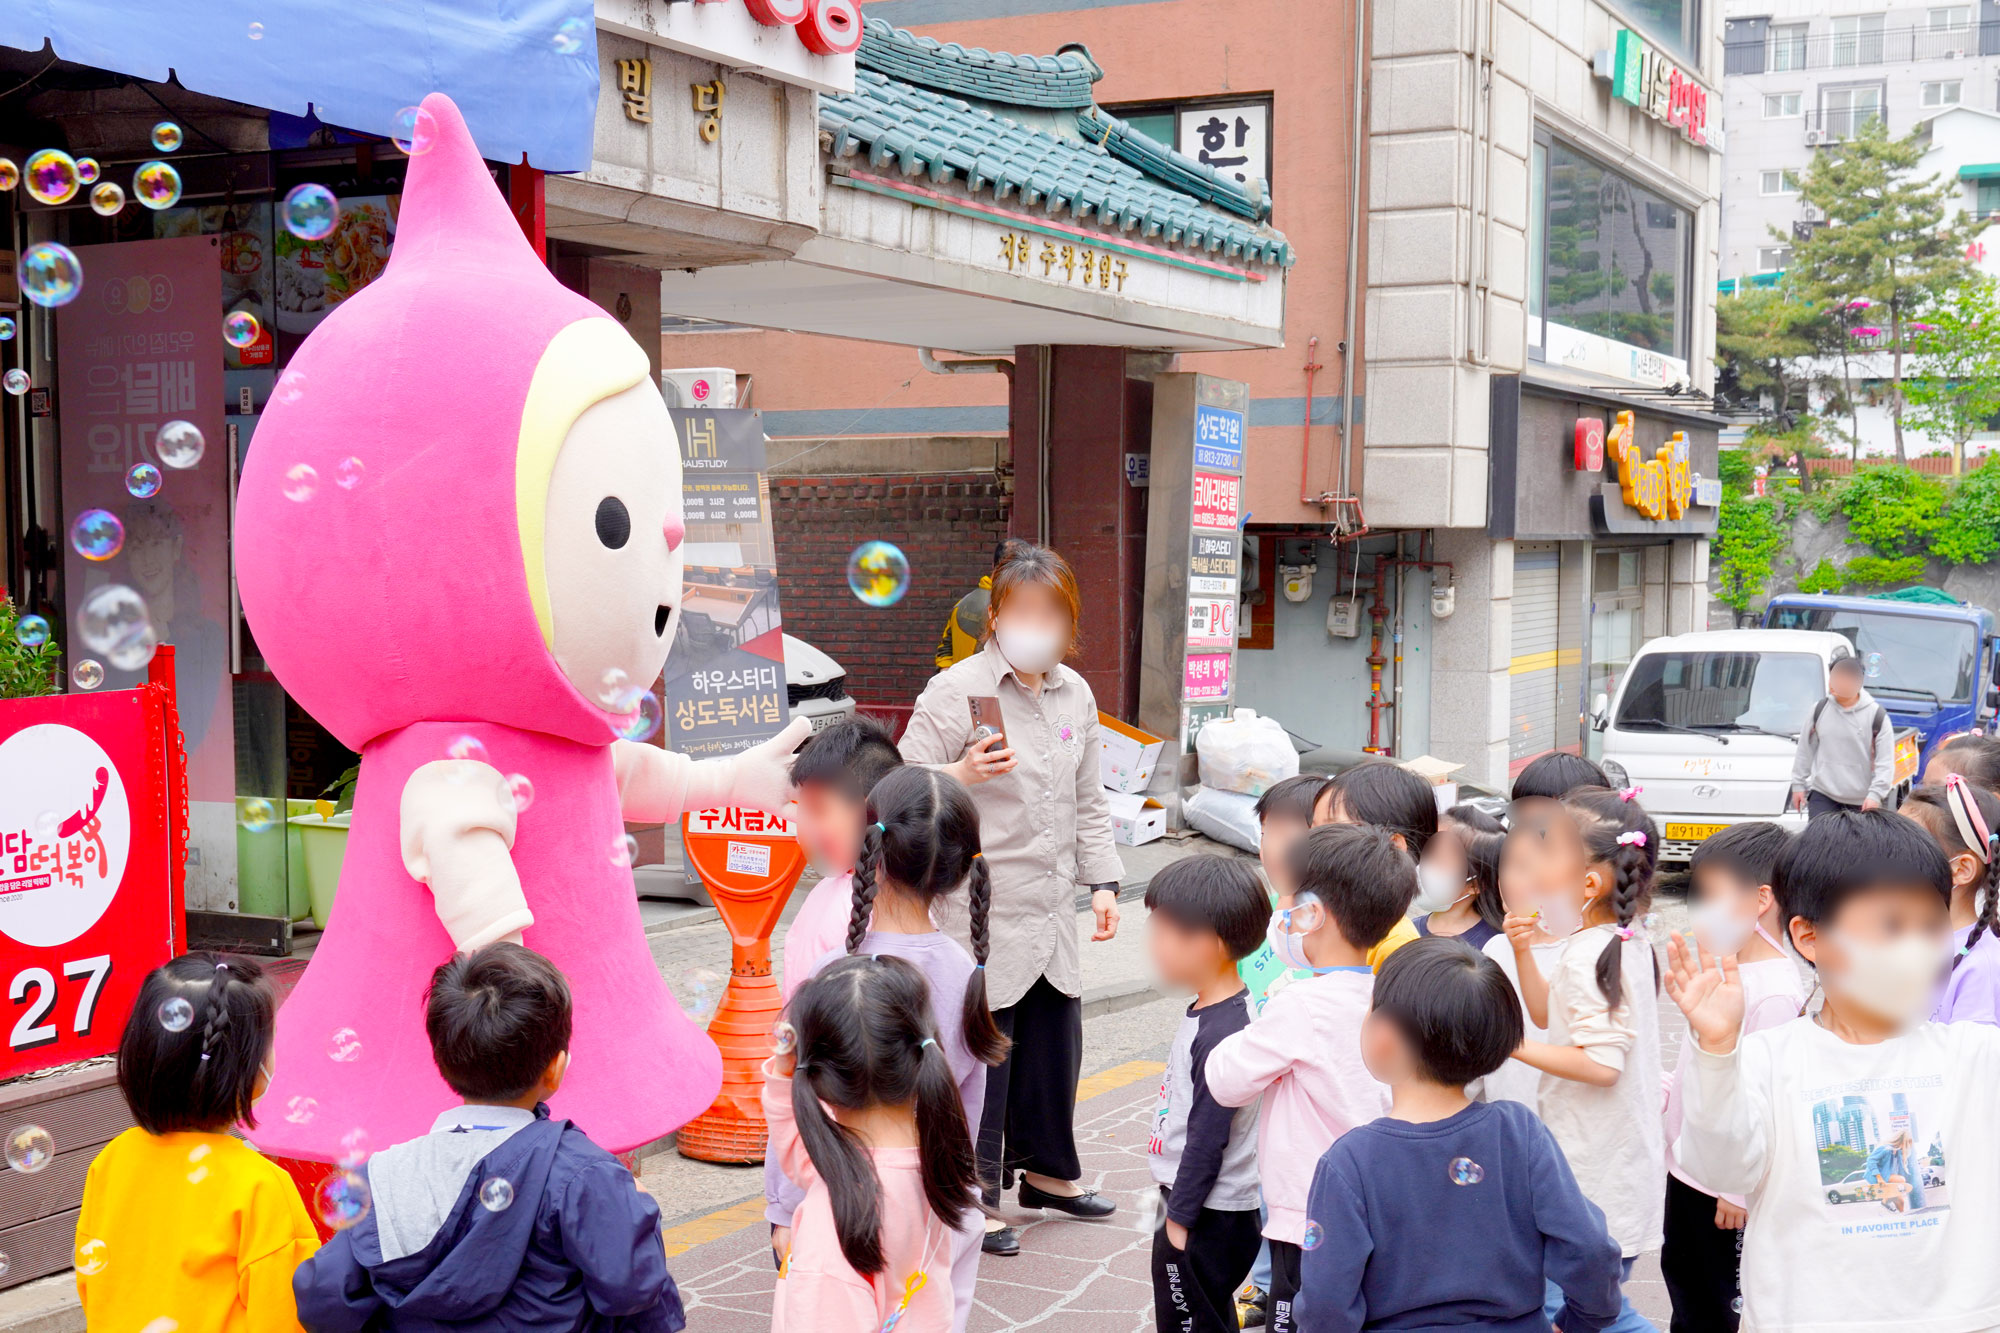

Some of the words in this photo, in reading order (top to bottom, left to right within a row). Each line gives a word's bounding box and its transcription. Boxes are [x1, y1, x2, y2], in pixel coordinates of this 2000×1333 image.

[998, 233, 1029, 270] 지하
[1199, 413, 1240, 445] 상도학원
[692, 666, 777, 694] 하우스터디
[676, 693, 780, 731] 상도독서실
[9, 954, 113, 1051] 27
[1841, 1226, 1853, 1235] IN
[1856, 1221, 1907, 1233] FAVORITE
[1909, 1218, 1939, 1228] PLACE
[1165, 1263, 1189, 1313] ENJOY
